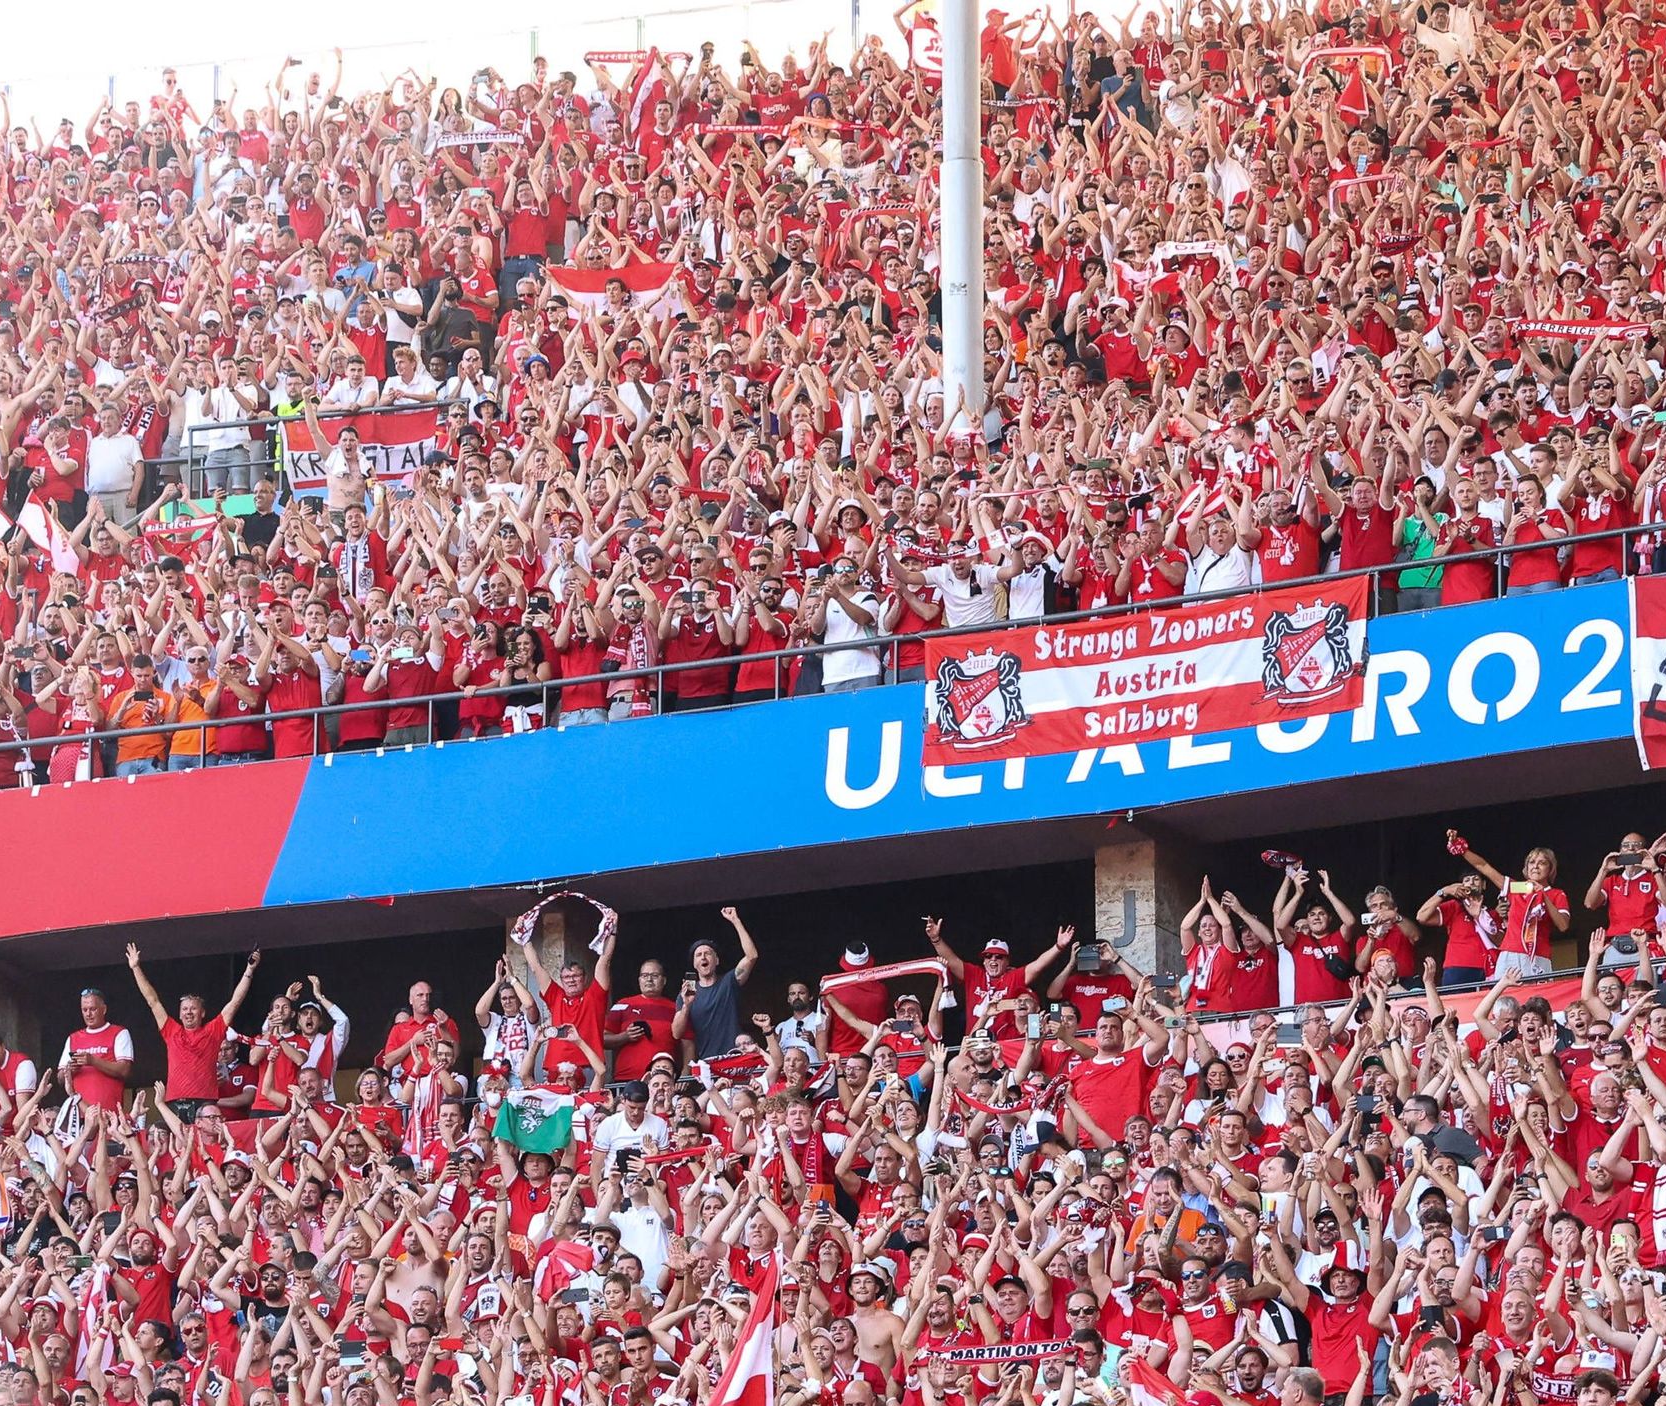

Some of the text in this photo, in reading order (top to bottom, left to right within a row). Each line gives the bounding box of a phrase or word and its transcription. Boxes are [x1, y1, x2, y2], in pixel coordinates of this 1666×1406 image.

[1034, 606, 1255, 662] Stranga Zoomers
[1094, 660, 1198, 699] Austria
[1084, 701, 1199, 739] Salzburg
[1114, 890, 1136, 948] J
[950, 1345, 1014, 1360] MARTIN
[1015, 1345, 1038, 1358] ON
